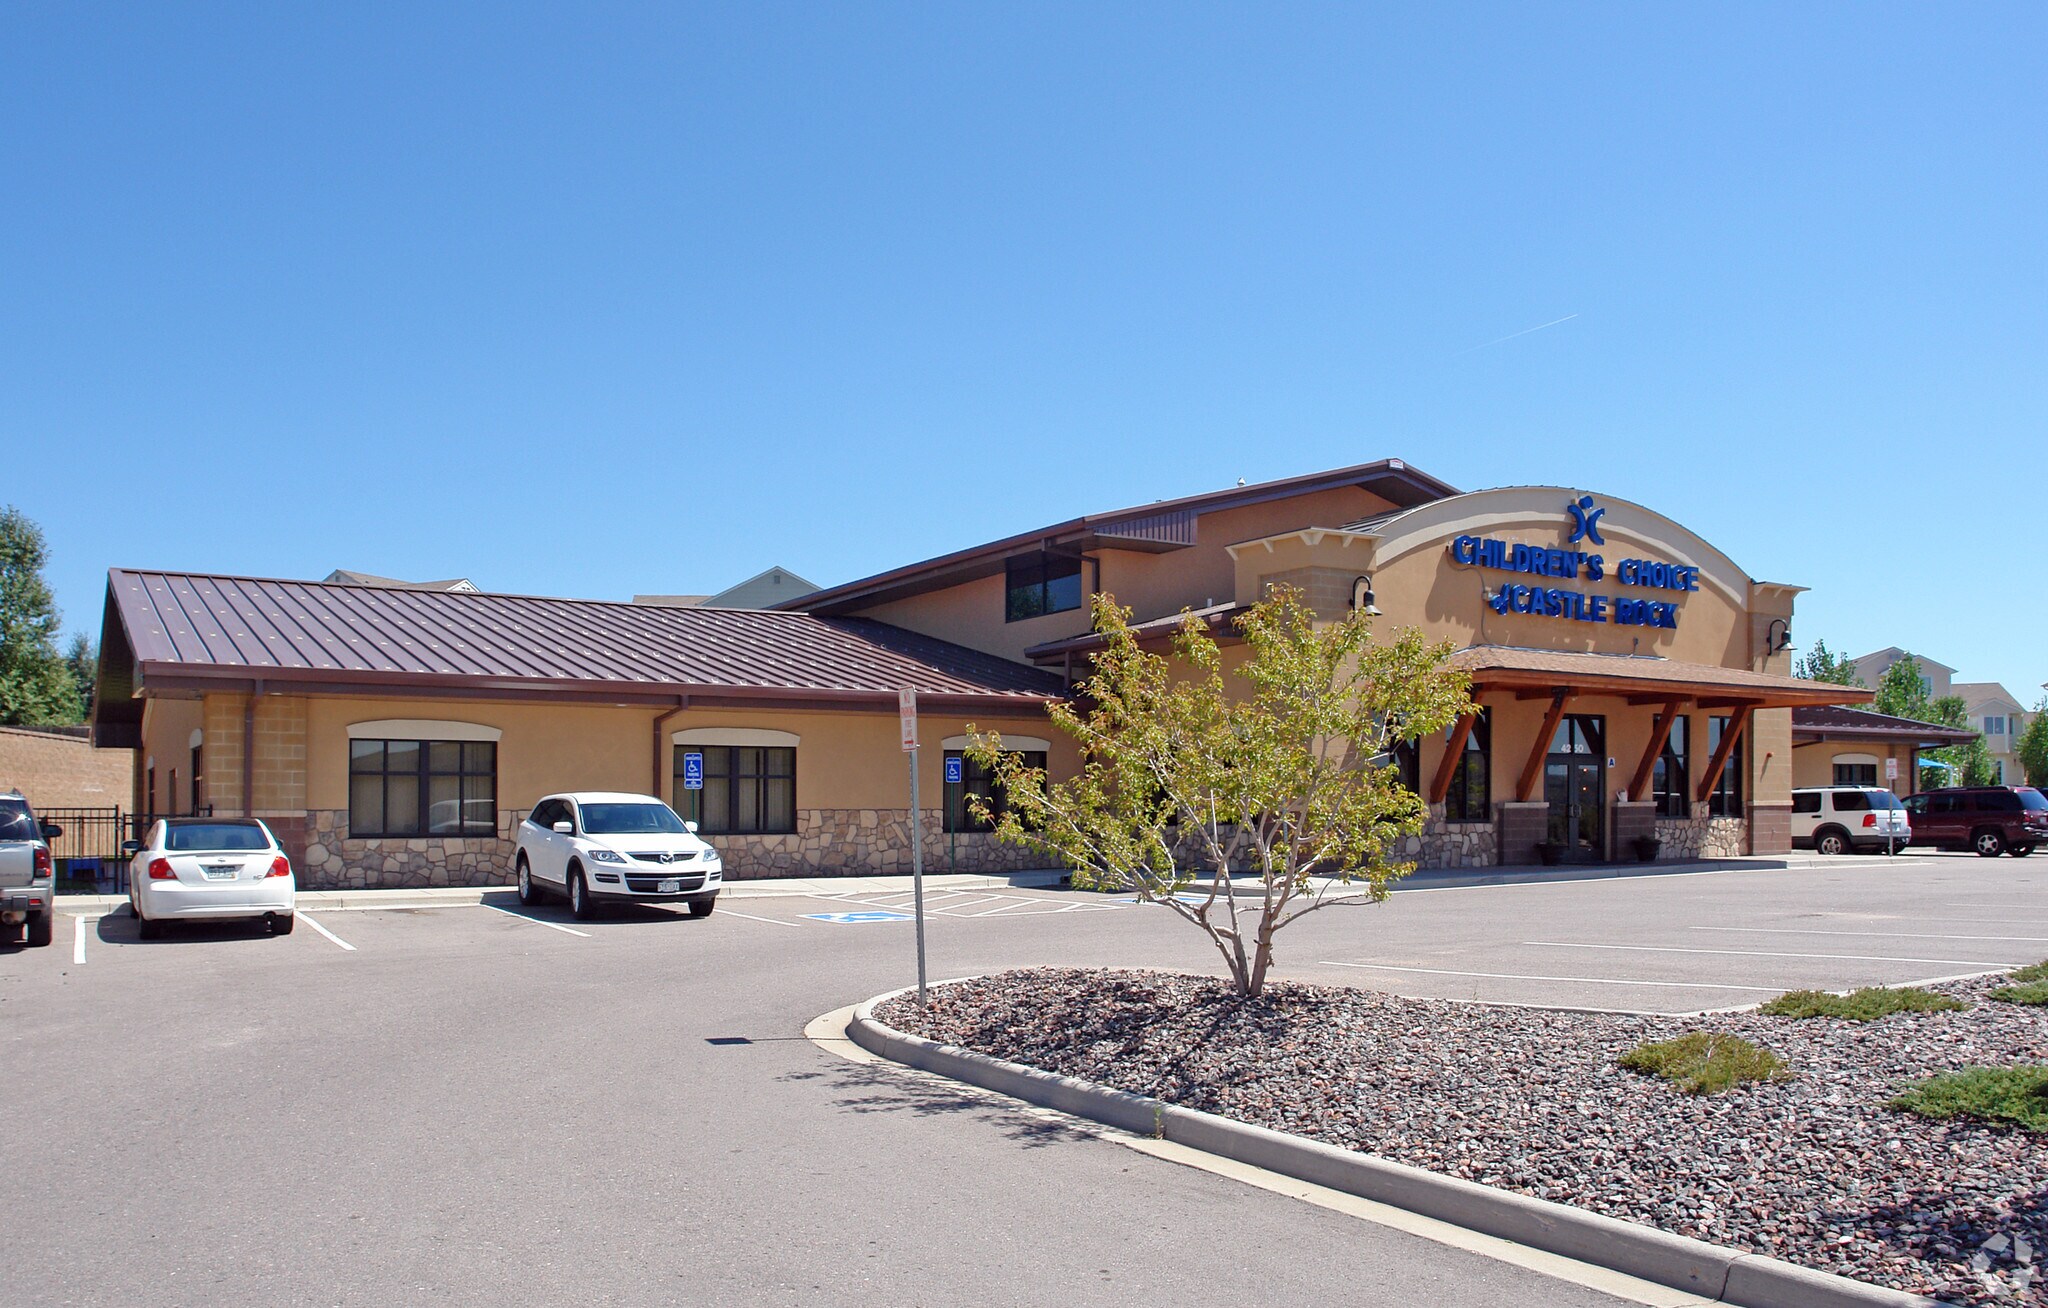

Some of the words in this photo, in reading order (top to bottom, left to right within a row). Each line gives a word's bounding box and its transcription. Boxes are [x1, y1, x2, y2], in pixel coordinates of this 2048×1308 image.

[1453, 535, 1604, 581] CHILDREN'S
[1618, 558, 1699, 592] CHOICE
[1510, 584, 1608, 622] CASTLE
[1614, 597, 1679, 629] ROCK
